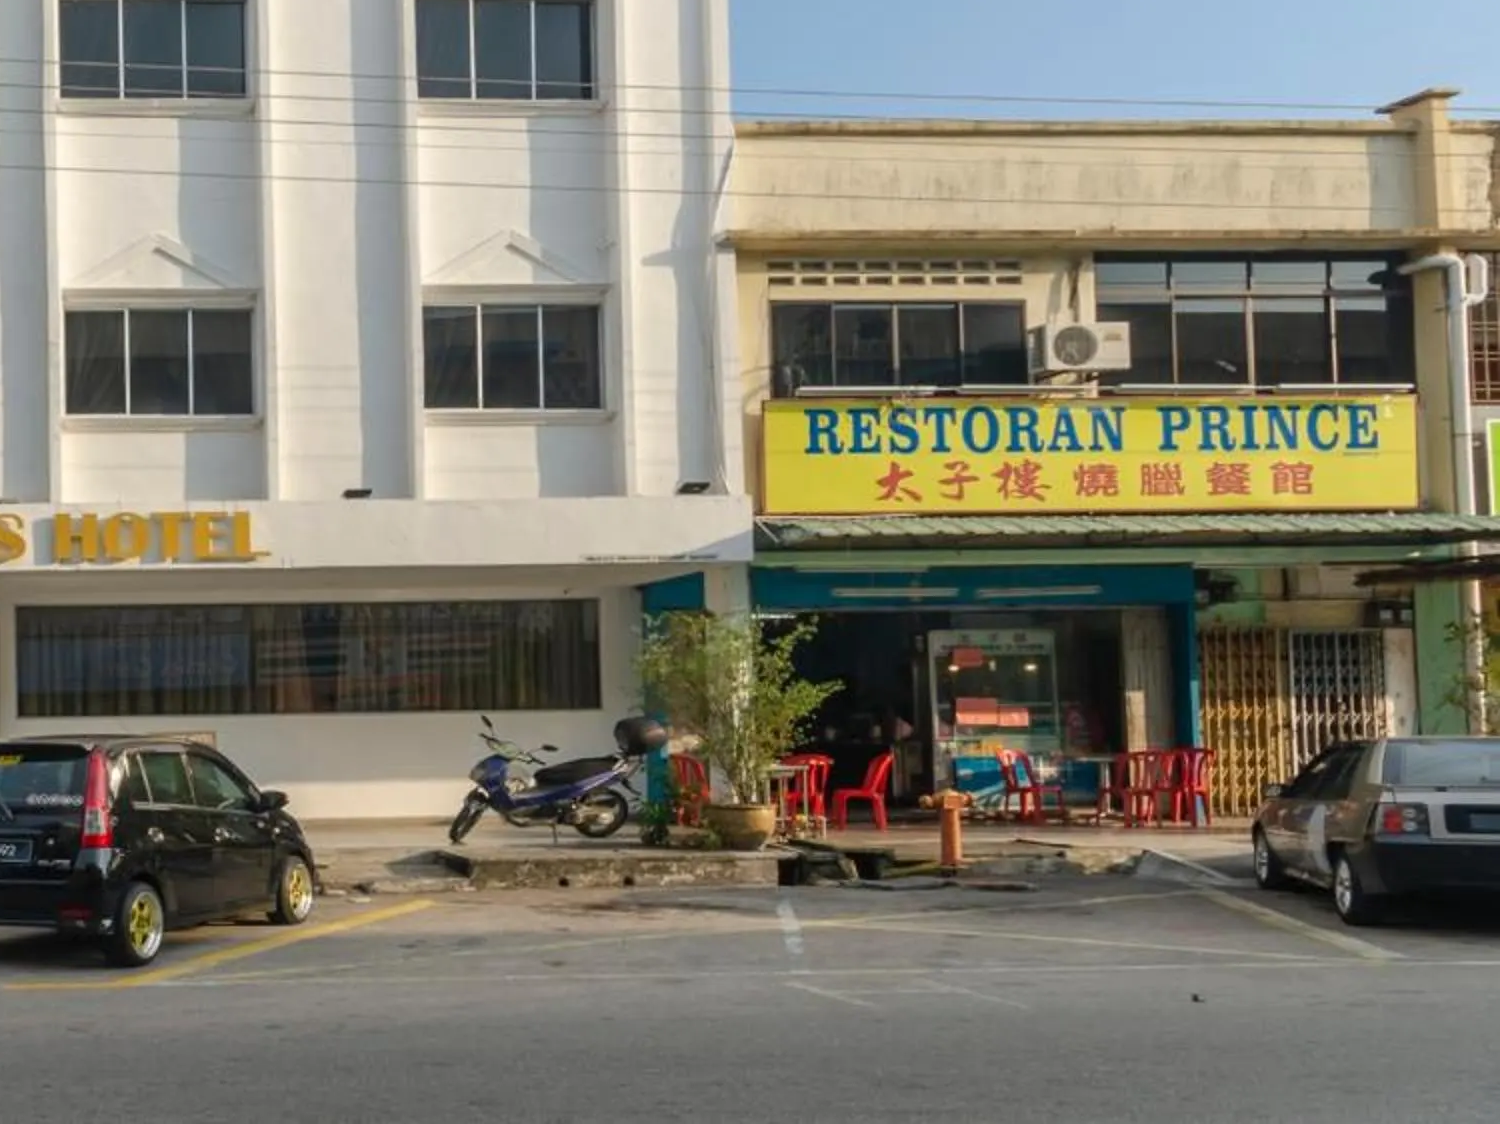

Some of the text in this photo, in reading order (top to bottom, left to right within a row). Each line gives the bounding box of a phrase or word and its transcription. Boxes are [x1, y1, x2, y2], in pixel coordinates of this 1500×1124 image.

[803, 402, 1380, 455] RESTORAN PRINCE
[53, 511, 271, 564] HOTEL
